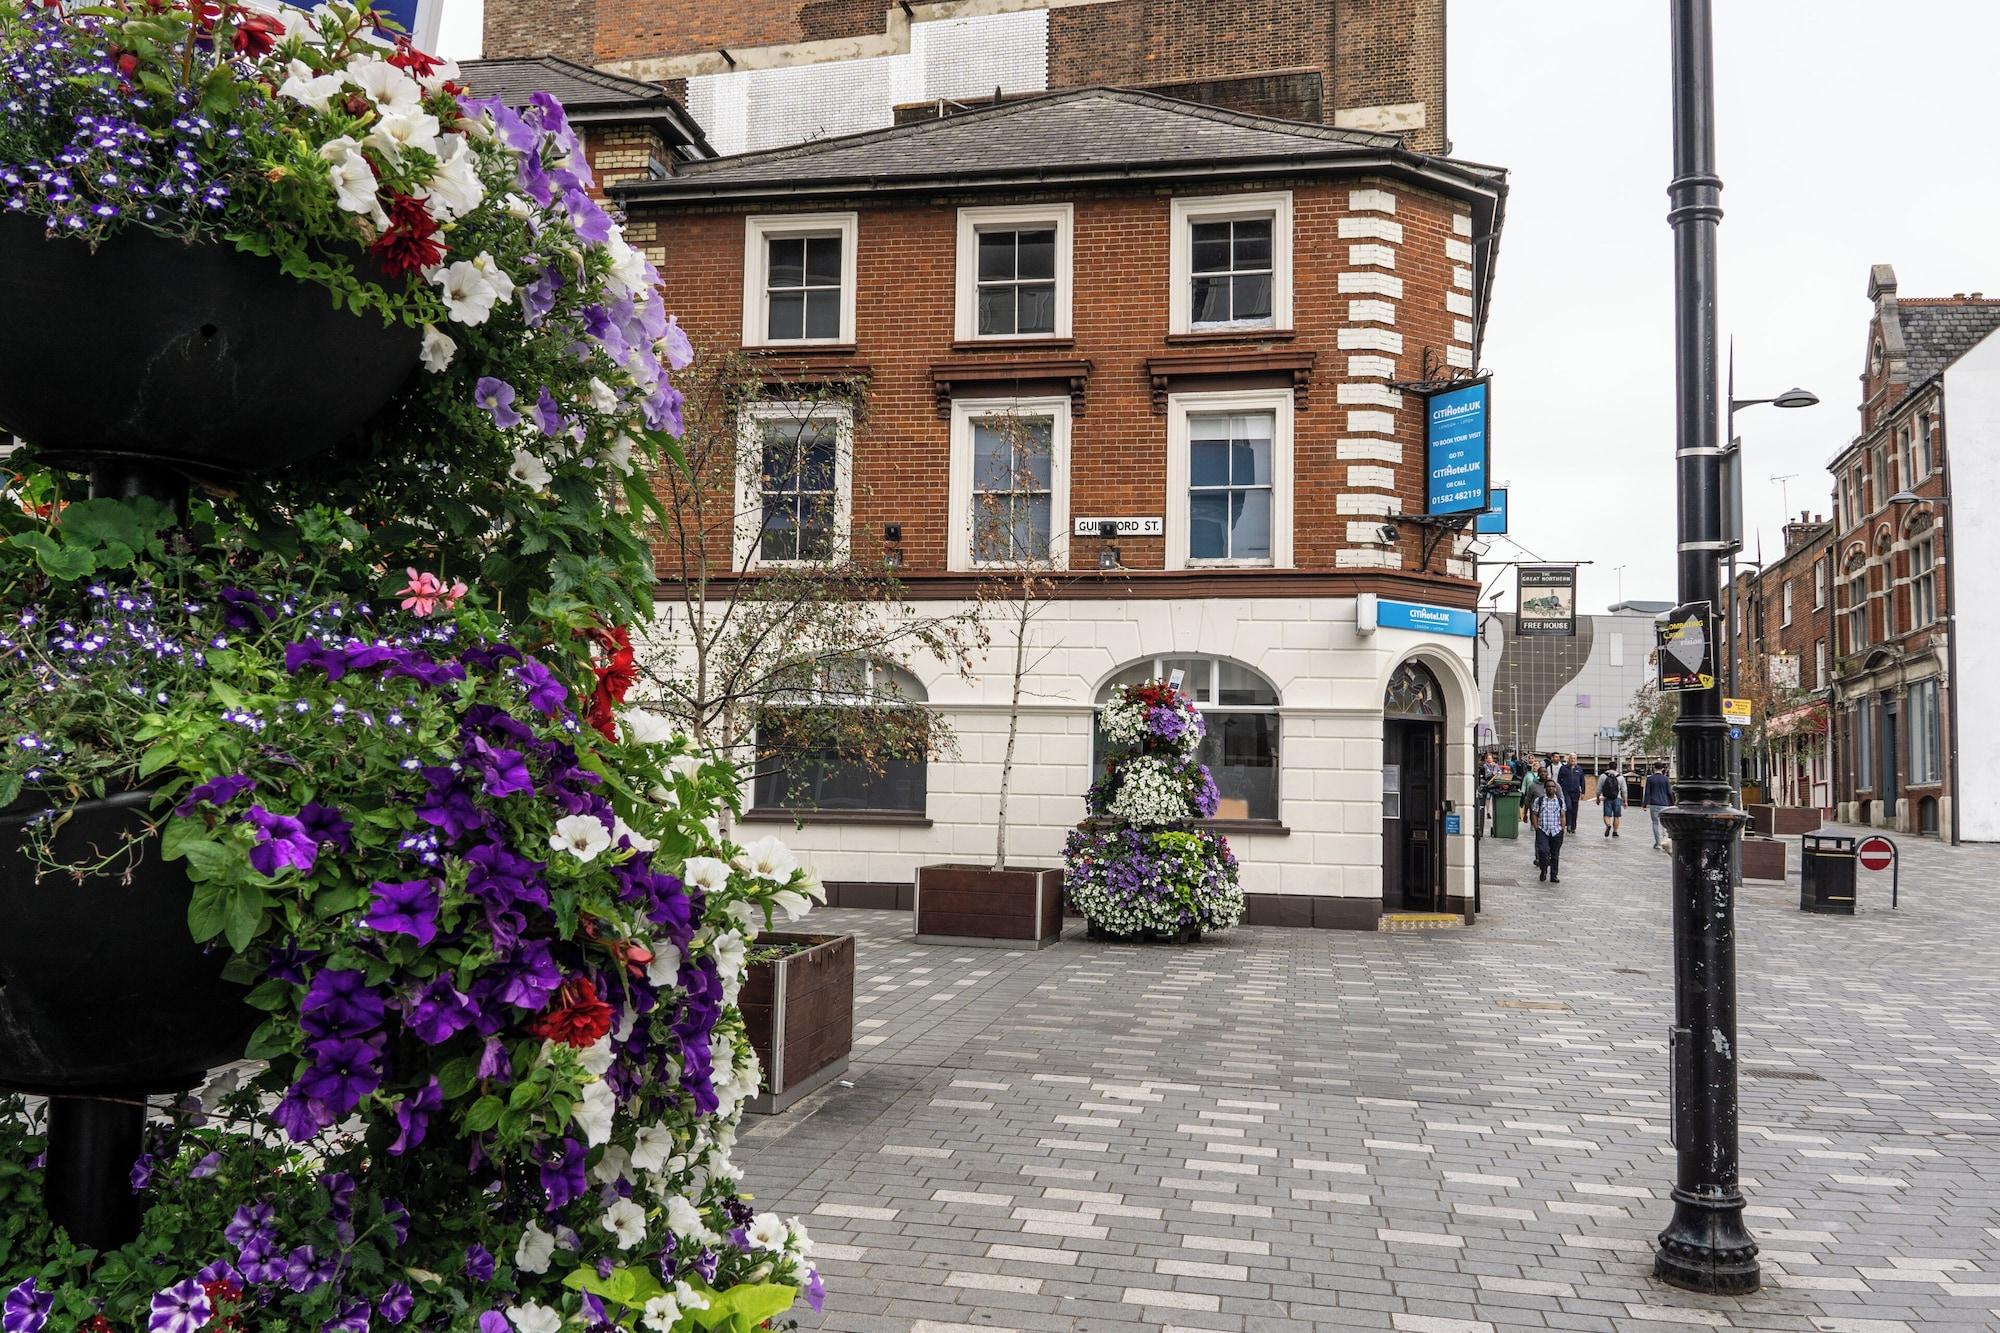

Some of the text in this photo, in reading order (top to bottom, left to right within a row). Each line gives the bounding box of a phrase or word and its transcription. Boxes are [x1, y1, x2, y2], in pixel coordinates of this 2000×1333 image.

[1440, 438, 1454, 446] BOOK
[1454, 435, 1468, 443] YOUR
[1468, 432, 1482, 440] VISIT
[1432, 489, 1482, 505] 01582 482119
[1144, 521, 1159, 531] ST.
